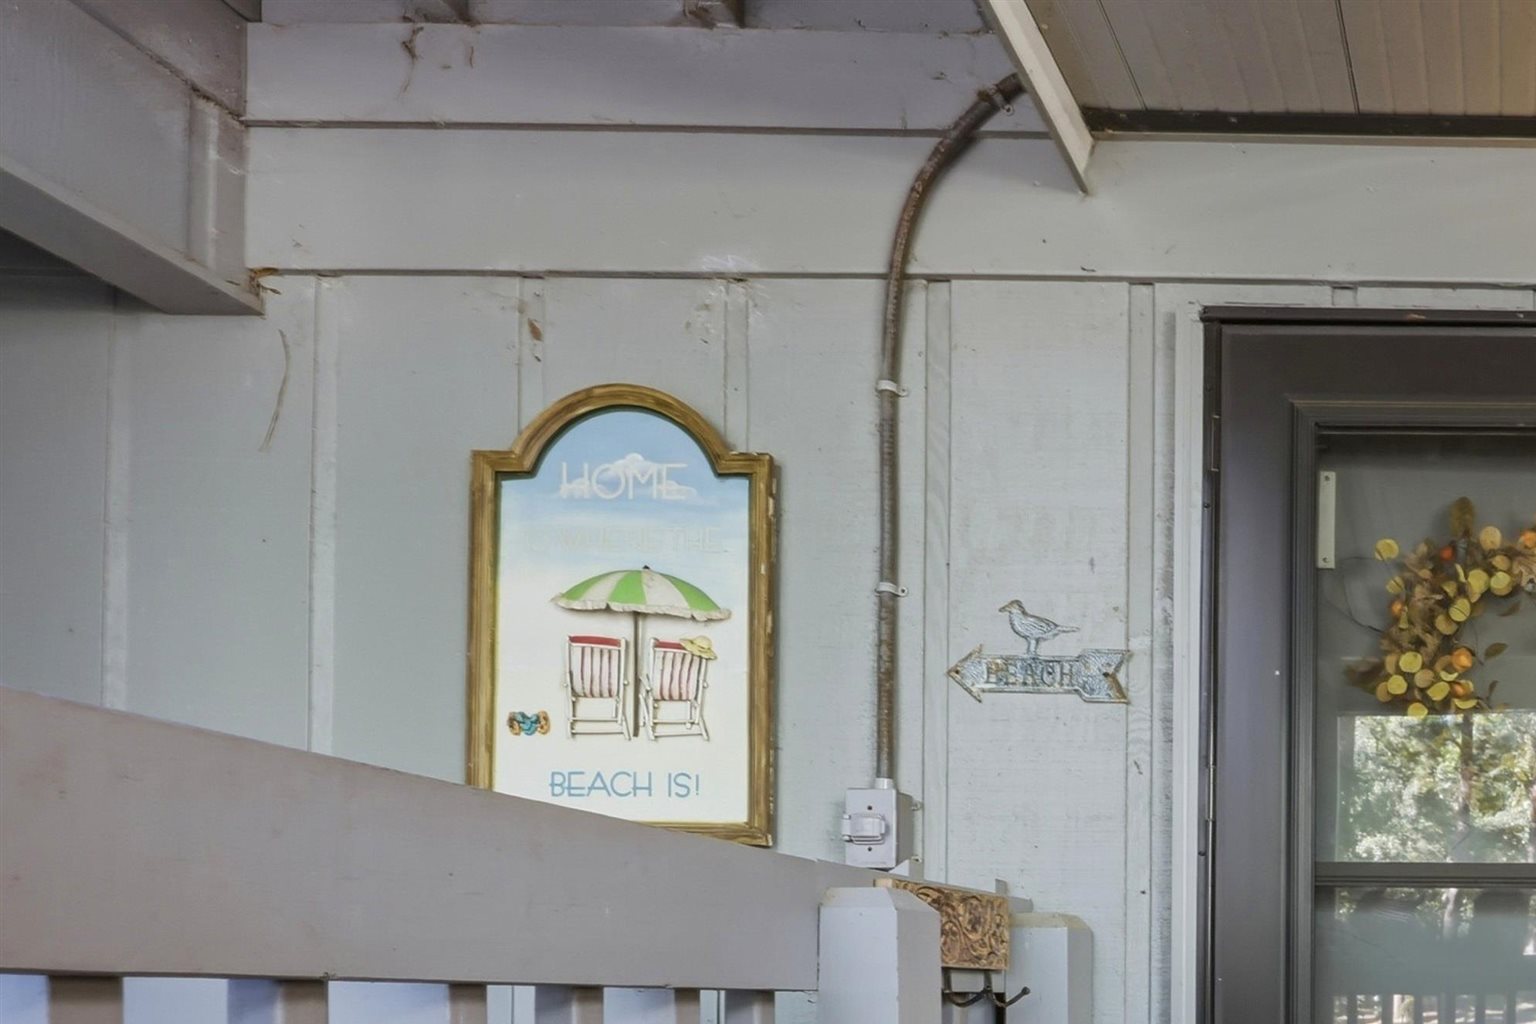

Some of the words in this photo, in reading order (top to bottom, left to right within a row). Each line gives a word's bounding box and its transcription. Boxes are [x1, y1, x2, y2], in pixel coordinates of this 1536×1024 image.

[560, 461, 689, 500] HOME
[984, 660, 1074, 688] BEACH
[548, 771, 652, 798] BEACH
[667, 772, 700, 798] IS!
